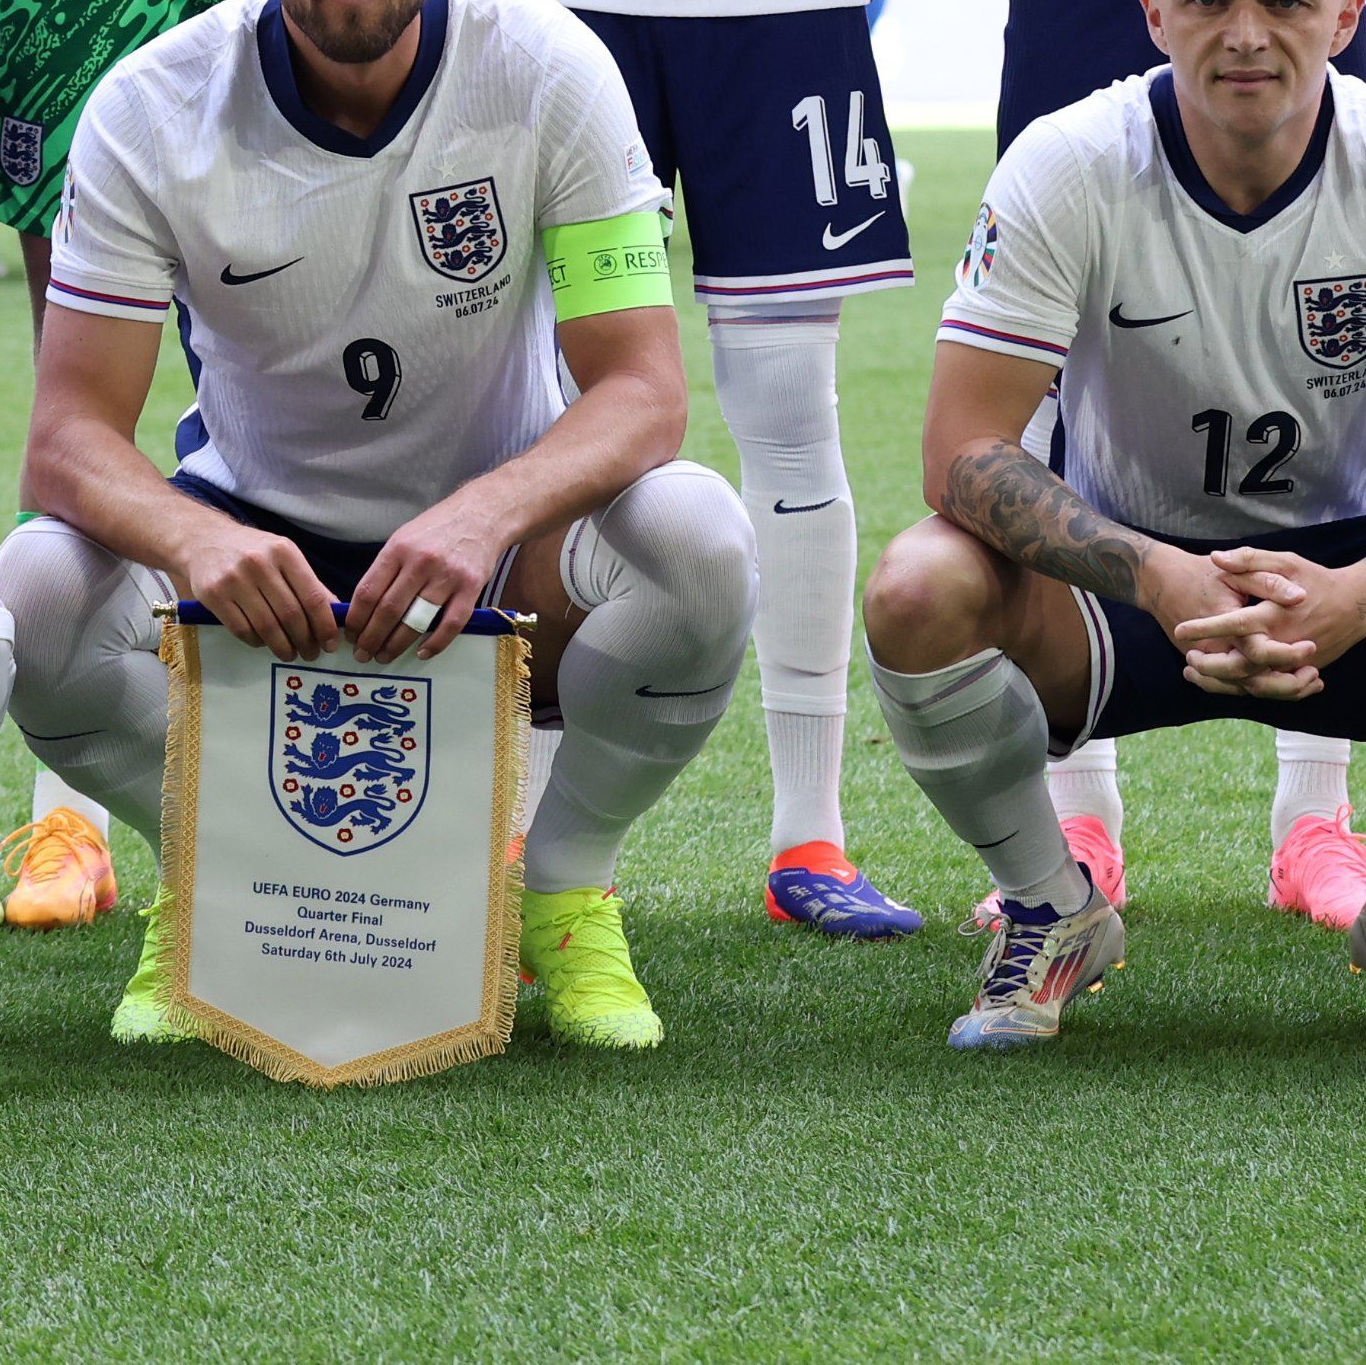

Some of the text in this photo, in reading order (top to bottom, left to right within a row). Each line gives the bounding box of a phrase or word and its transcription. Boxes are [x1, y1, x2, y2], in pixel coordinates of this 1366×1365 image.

[792, 90, 891, 206] 14
[436, 274, 511, 308] SWITZERLAND
[455, 295, 499, 318] 06.07.24
[342, 338, 402, 421] 9
[1323, 380, 1366, 399] 06.07.24
[1191, 409, 1302, 497] 12
[253, 882, 430, 913] UEFA EURO 2024 Germany
[297, 906, 383, 926] Quarter Final
[245, 921, 437, 952] Dusseldorf Arena, Dusseldorf
[261, 943, 413, 969] Saturday 6th July 2024
